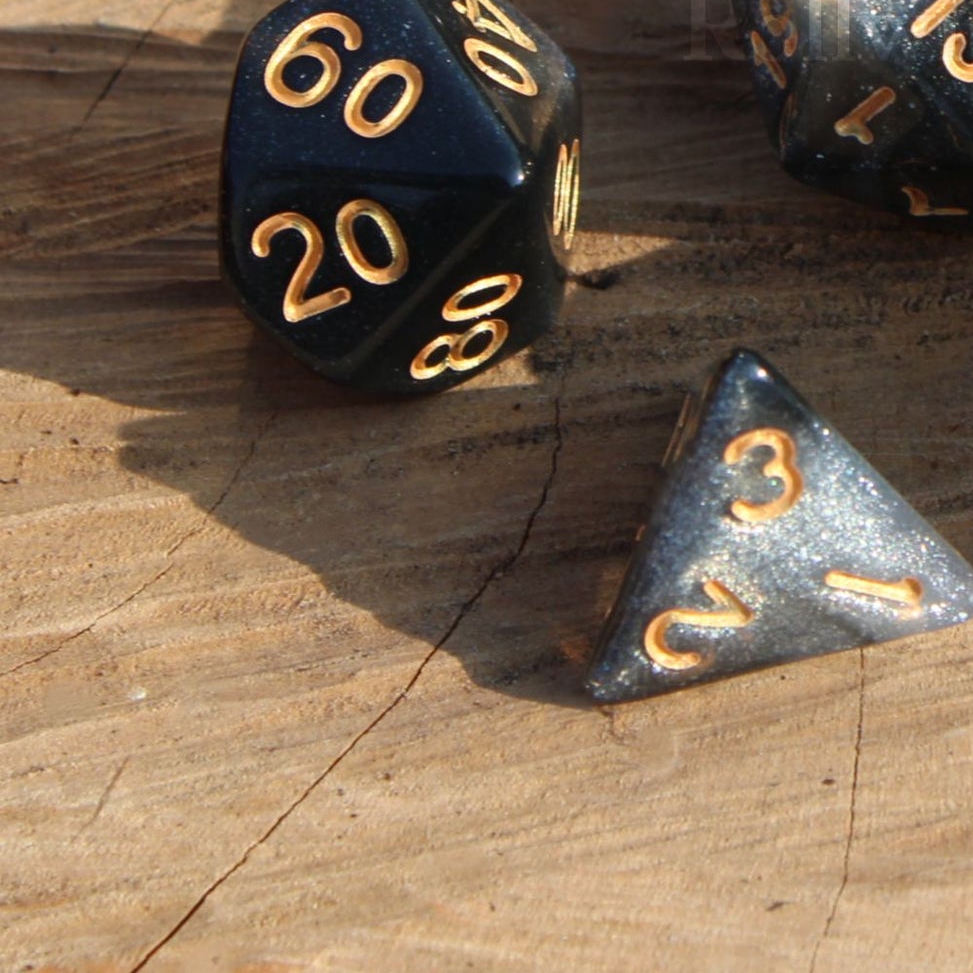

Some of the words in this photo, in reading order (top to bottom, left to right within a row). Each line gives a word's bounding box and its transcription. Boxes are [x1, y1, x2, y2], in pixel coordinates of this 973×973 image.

[264, 12, 424, 138] 60
[251, 199, 409, 322] 20
[410, 273, 523, 380] 80
[723, 428, 803, 523] 3
[644, 580, 754, 670] 2
[824, 570, 923, 620] 1
